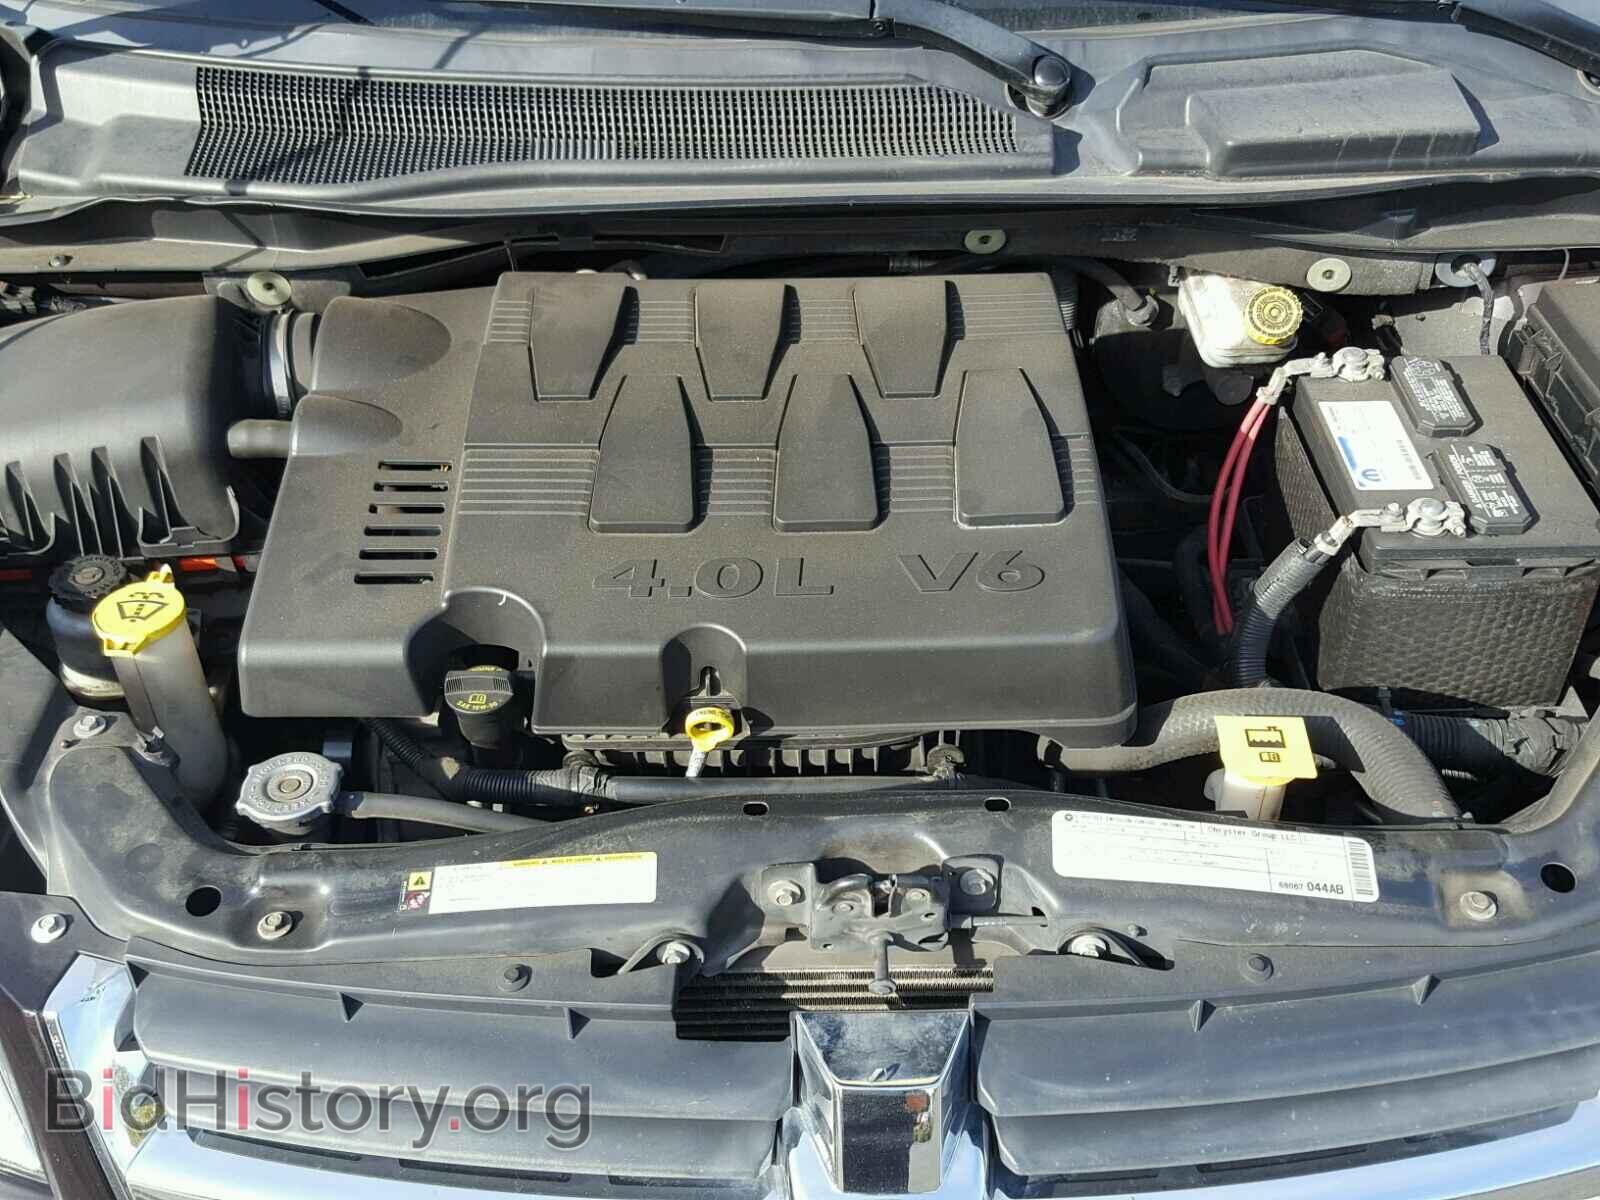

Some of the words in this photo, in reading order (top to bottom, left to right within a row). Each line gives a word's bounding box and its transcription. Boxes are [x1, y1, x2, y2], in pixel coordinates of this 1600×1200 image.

[592, 557, 834, 598] 4.0L
[897, 550, 1046, 592] V6
[1251, 830, 1276, 841] Group
[1307, 881, 1344, 894] 044AB
